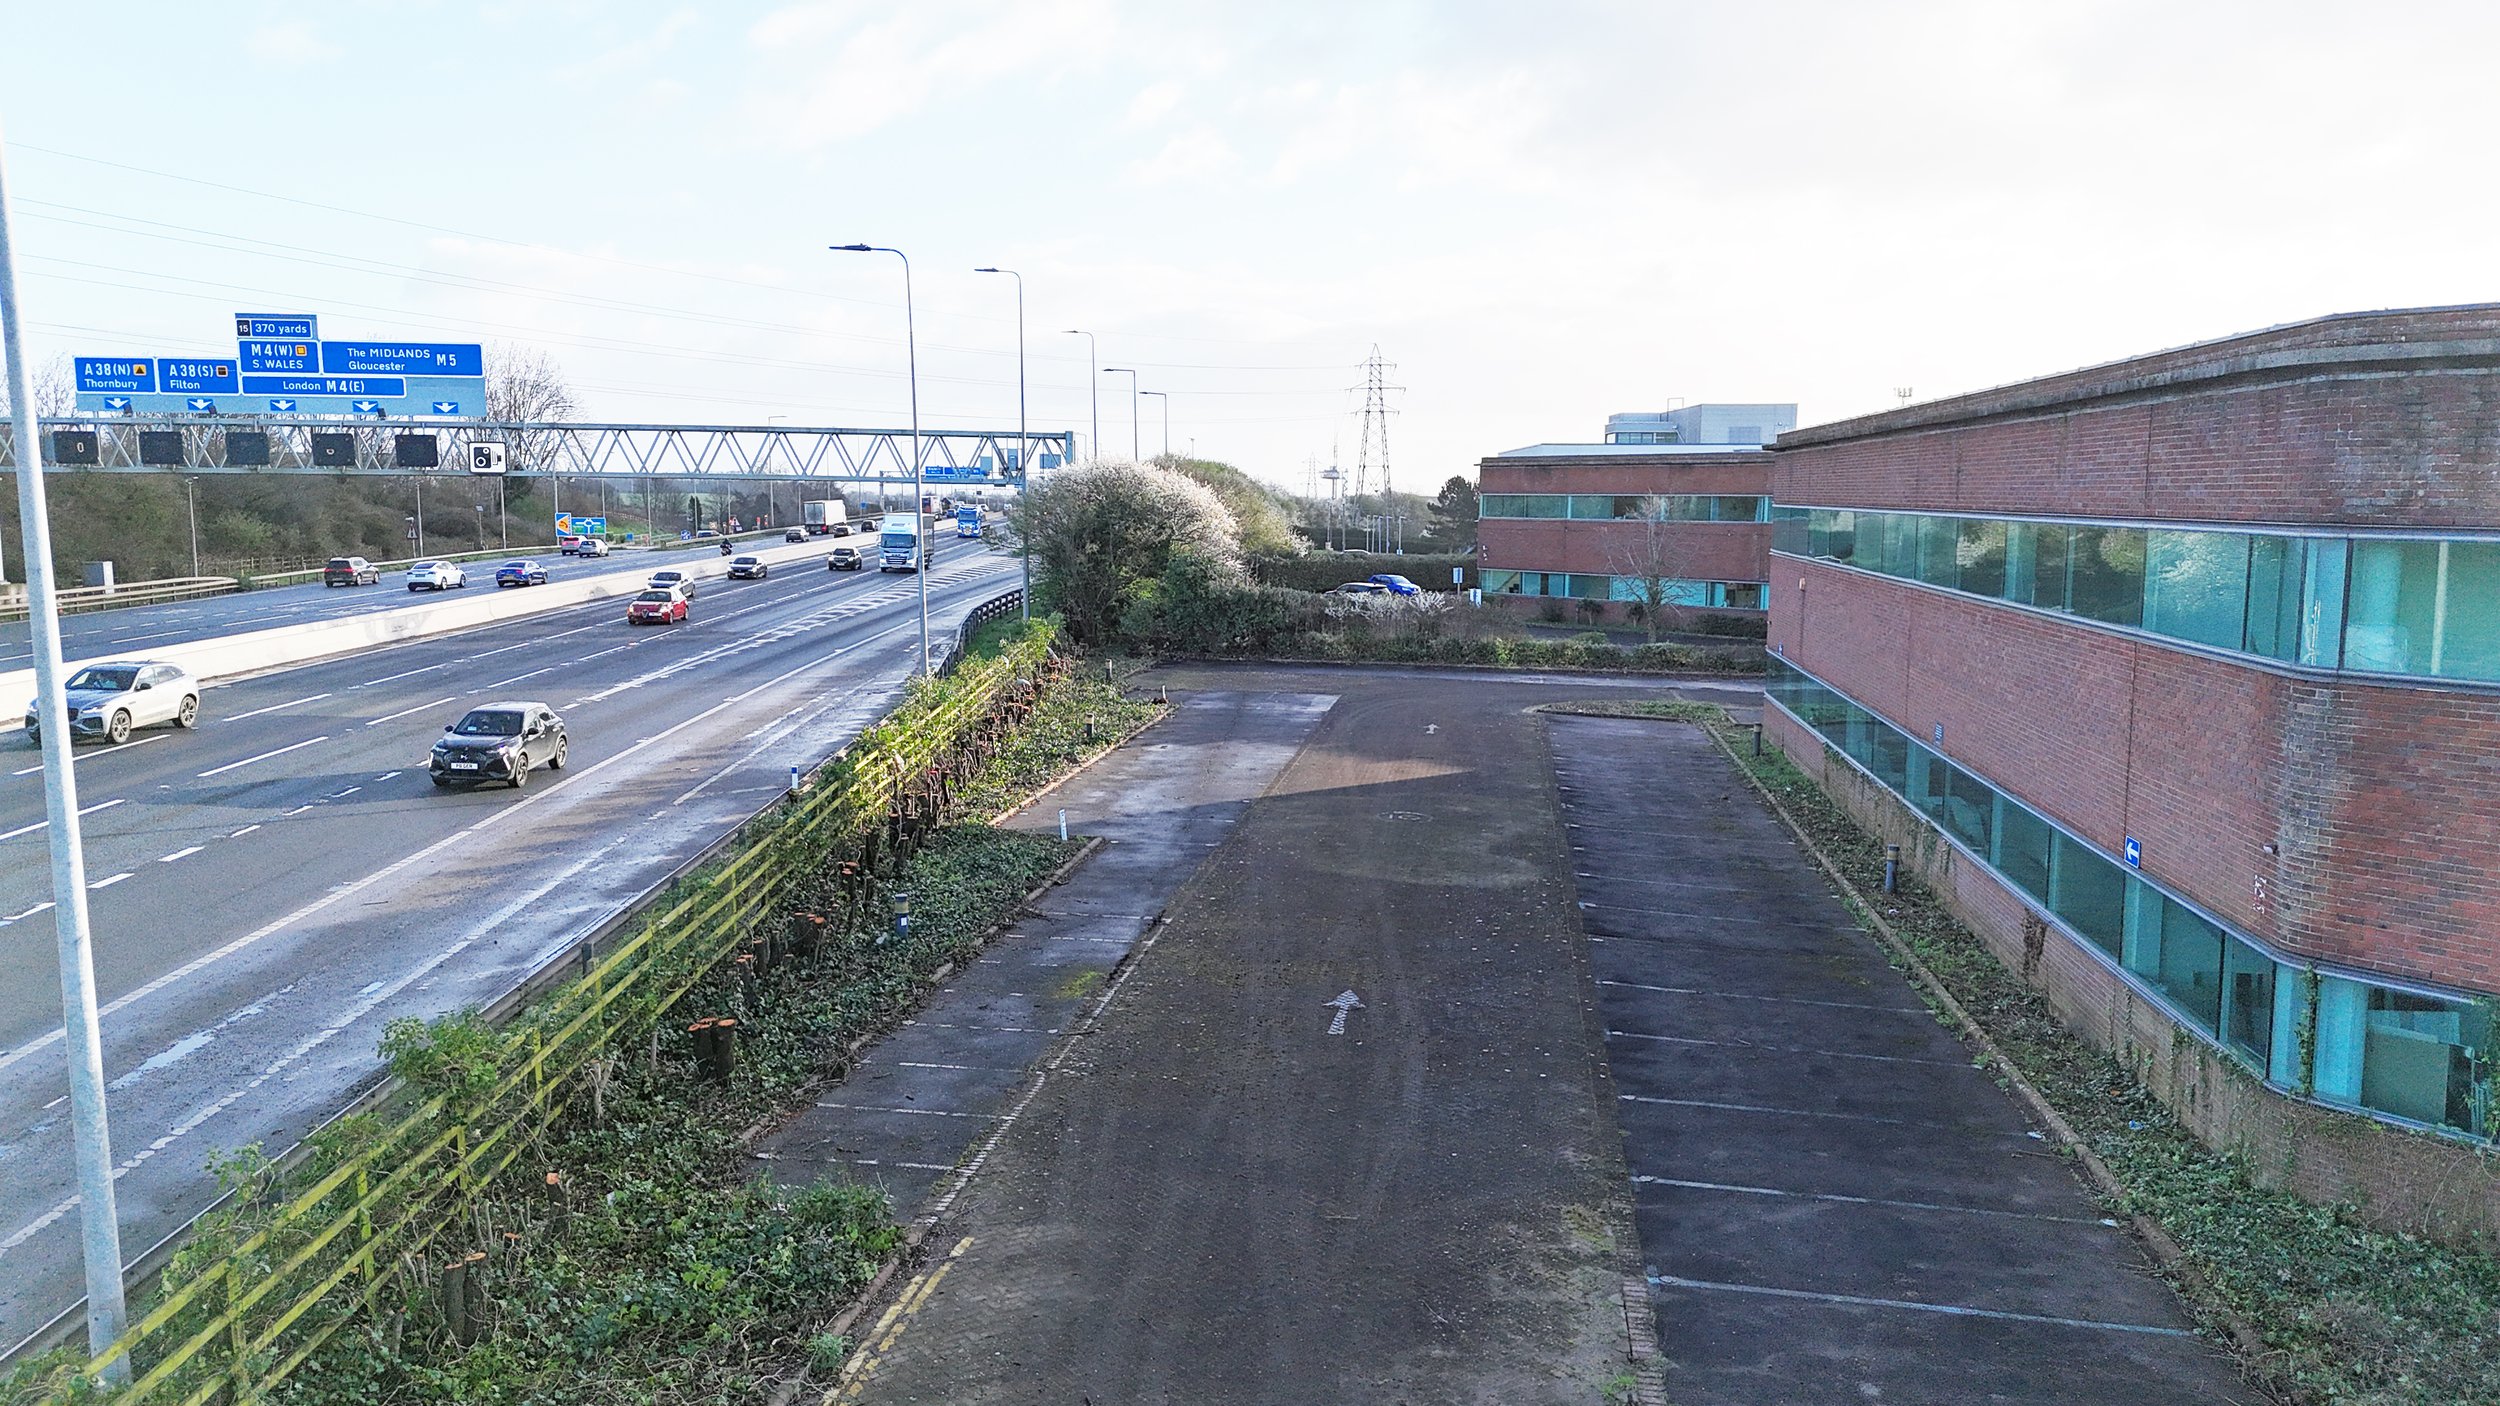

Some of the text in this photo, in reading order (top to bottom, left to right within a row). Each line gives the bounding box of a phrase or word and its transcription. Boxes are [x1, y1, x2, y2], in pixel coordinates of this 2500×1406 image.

[239, 324, 249, 333] 15
[255, 323, 307, 335] 370 yards
[347, 347, 431, 359] The MIDLANDS
[265, 360, 304, 369] WALES
[348, 360, 406, 371] Gloucester
[84, 378, 138, 390] Thornbury
[170, 379, 201, 390] Filton
[282, 380, 321, 391] London
